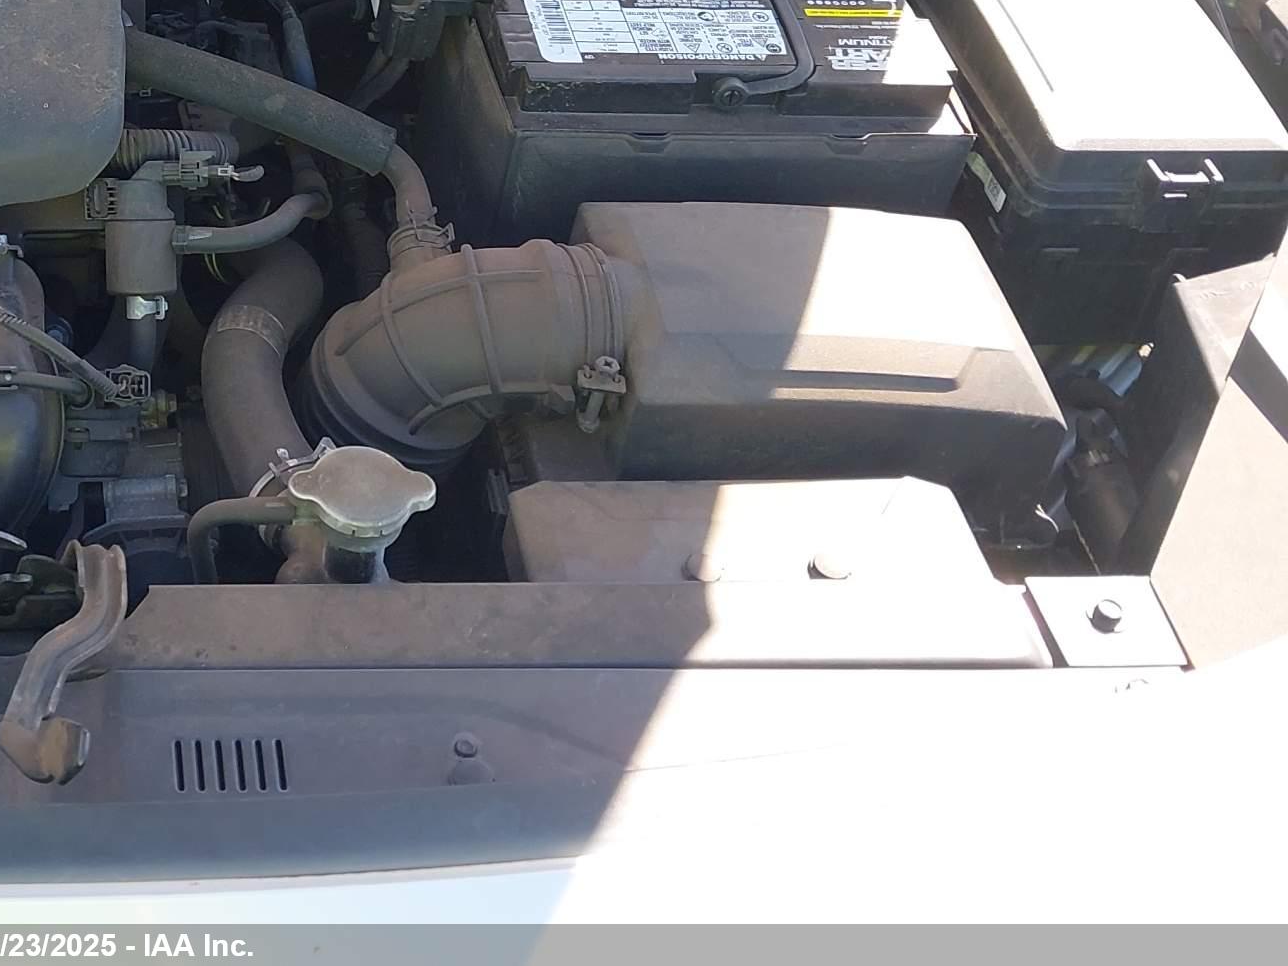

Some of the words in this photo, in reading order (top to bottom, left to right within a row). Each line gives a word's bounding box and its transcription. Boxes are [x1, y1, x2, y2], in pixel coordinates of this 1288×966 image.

[838, 38, 895, 46] ATINUM
[657, 53, 755, 61] DANGER/POISON
[826, 49, 890, 61] ART
[832, 60, 889, 71] PER
